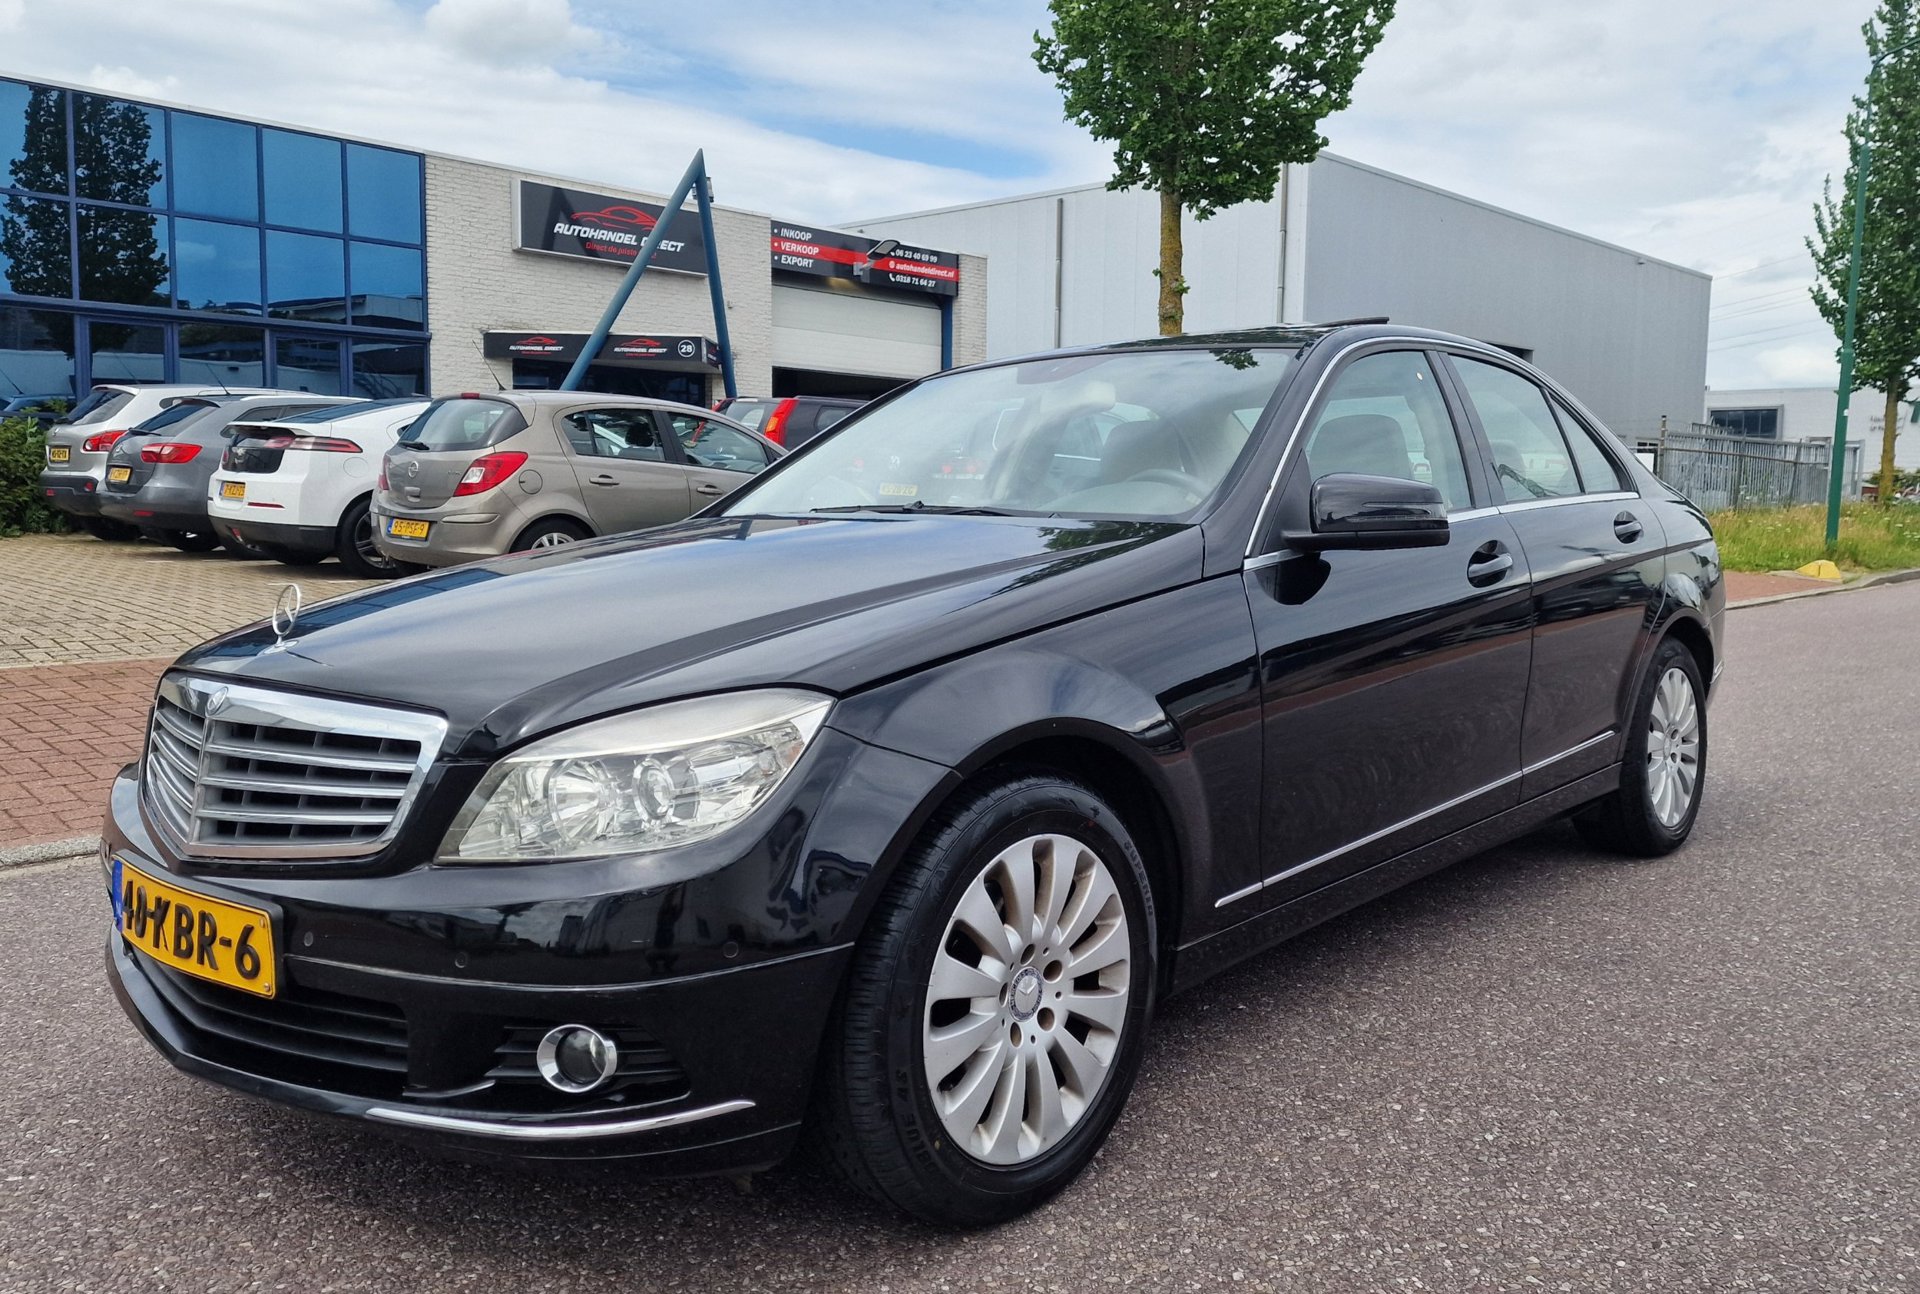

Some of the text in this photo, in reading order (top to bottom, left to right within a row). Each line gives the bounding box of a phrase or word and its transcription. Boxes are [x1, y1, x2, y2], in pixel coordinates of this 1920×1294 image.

[554, 222, 685, 252] AUTOHANDEL DECT
[780, 227, 812, 241] INKOOP
[585, 241, 607, 252] Direct
[608, 245, 617, 253] de
[780, 242, 820, 255] VERKOOP
[780, 255, 814, 269] EXPORT
[904, 250, 913, 259] 23
[913, 252, 921, 260] 40
[895, 262, 955, 279] autohandeldirect.nl
[895, 274, 936, 288] 0318 71 64 27
[681, 344, 693, 353] 28
[123, 879, 261, 980] 40-KBR-6
